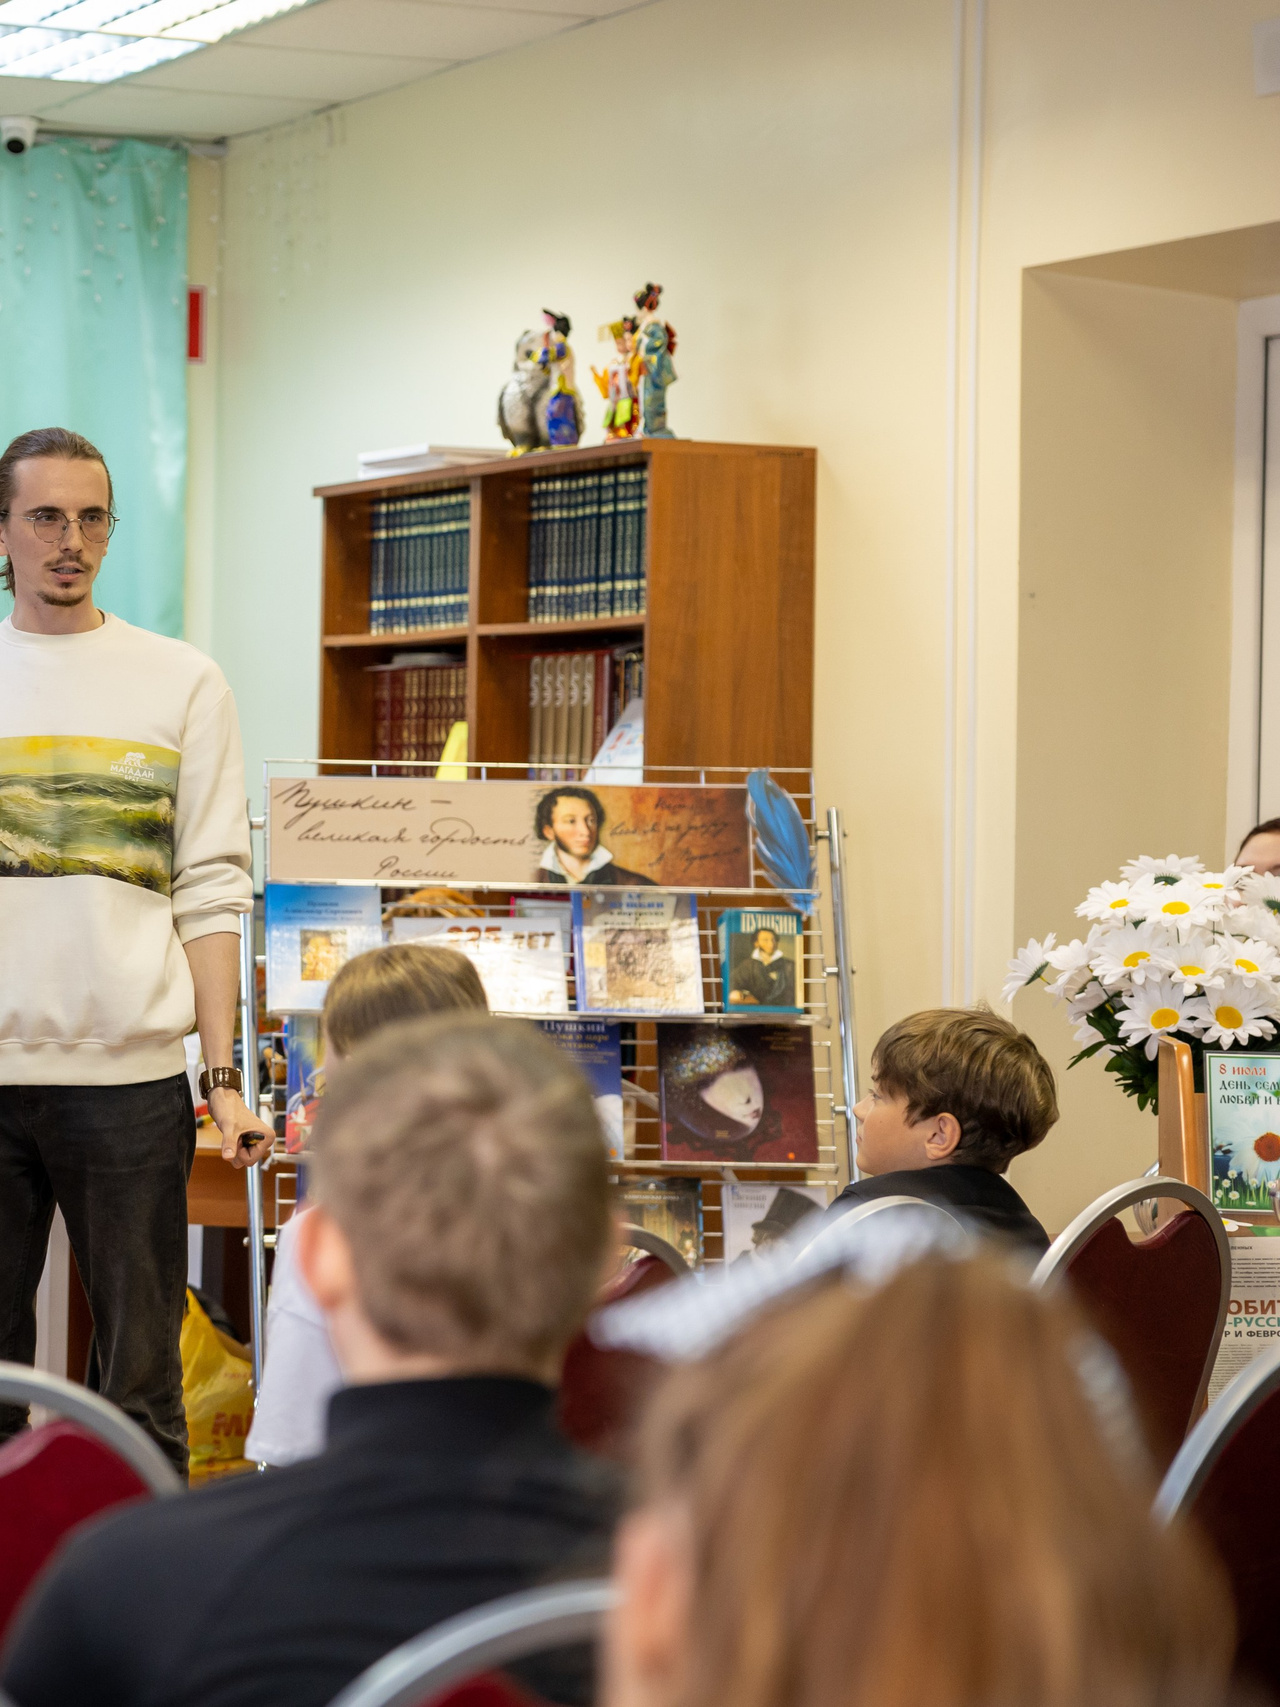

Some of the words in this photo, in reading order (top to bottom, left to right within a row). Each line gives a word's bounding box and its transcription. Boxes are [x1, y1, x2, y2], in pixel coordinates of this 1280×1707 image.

[111, 764, 155, 779] МАГАДАН
[274, 781, 417, 831] Пушкин
[297, 820, 412, 843] великая
[419, 816, 529, 856] гордость
[373, 855, 459, 878] России
[1219, 1063, 1227, 1075] 8
[1219, 1080, 1251, 1091] ДЕНЬ
[1219, 1094, 1260, 1105] ЛЮБВИ
[1227, 1299, 1280, 1315] ОБИ
[1227, 1317, 1280, 1328] -РУСС
